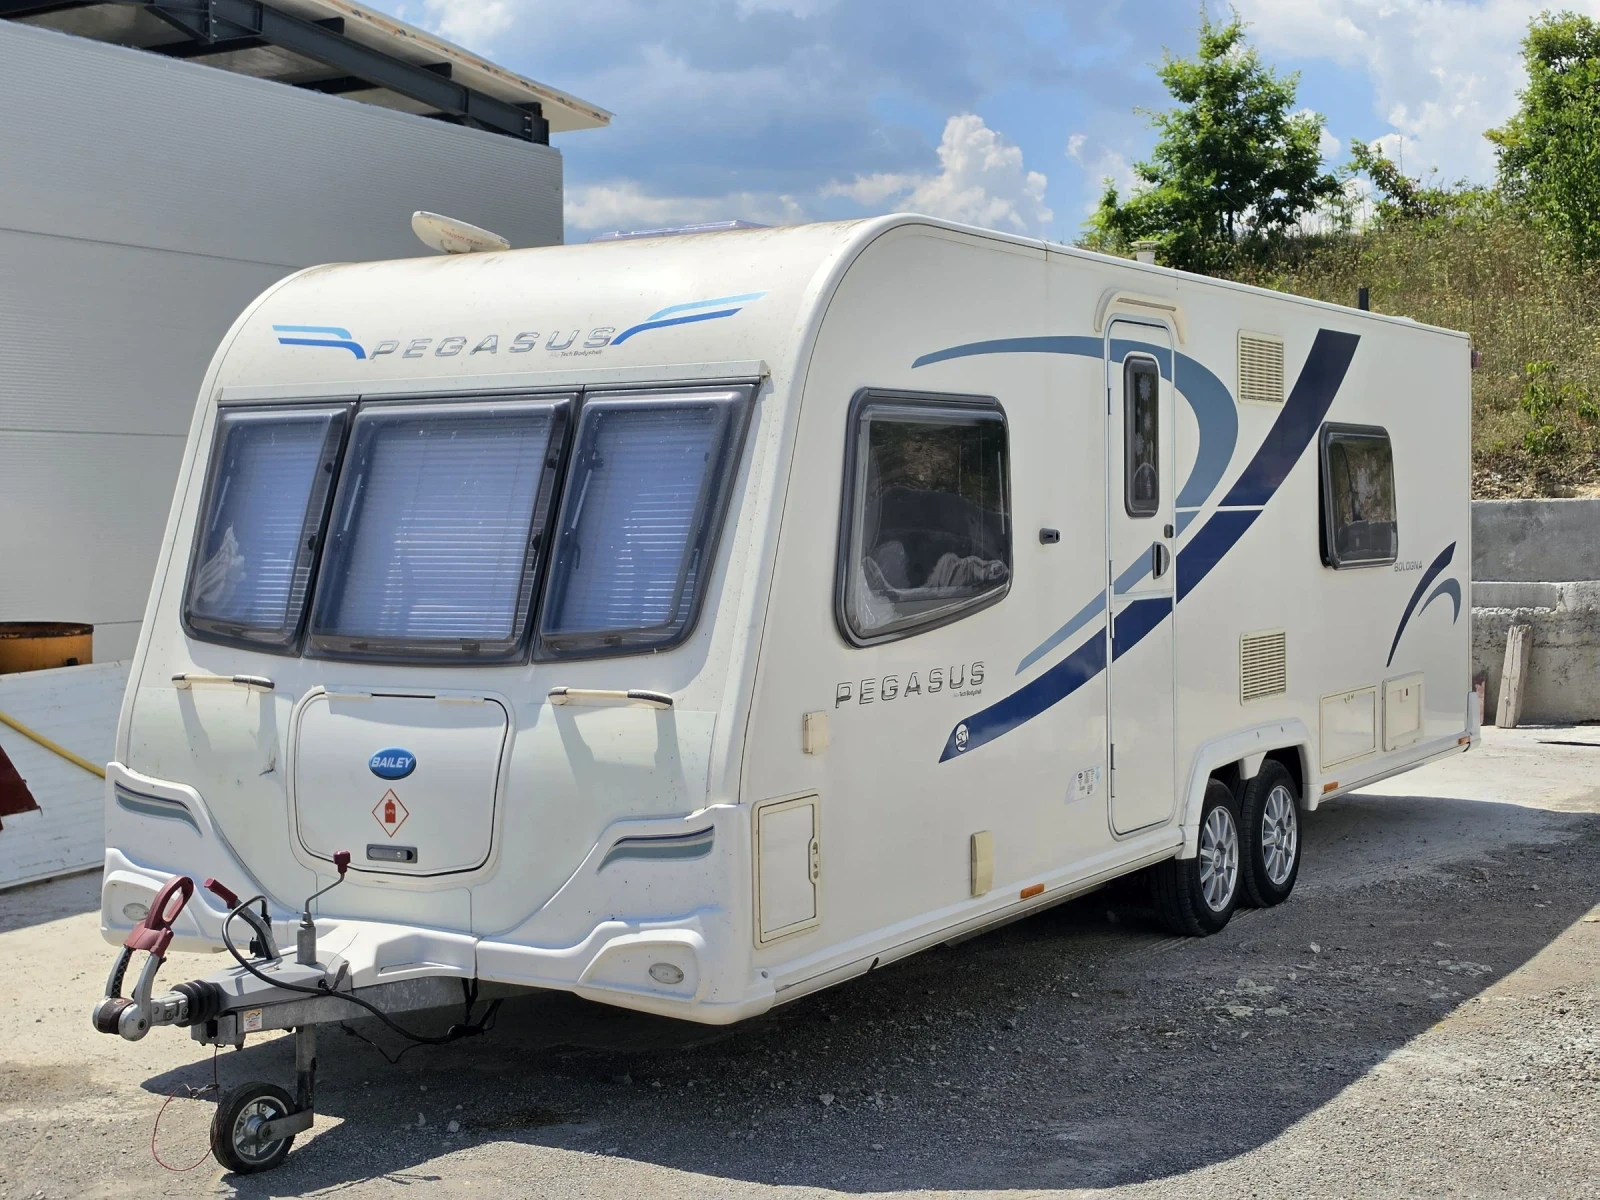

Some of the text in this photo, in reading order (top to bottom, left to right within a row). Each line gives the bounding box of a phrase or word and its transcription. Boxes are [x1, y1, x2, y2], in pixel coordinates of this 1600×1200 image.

[369, 327, 616, 360] PEGASUS
[1394, 560, 1422, 572] BOLOGNA
[835, 661, 985, 708] PEGASUS
[371, 757, 413, 768] BAILEY
